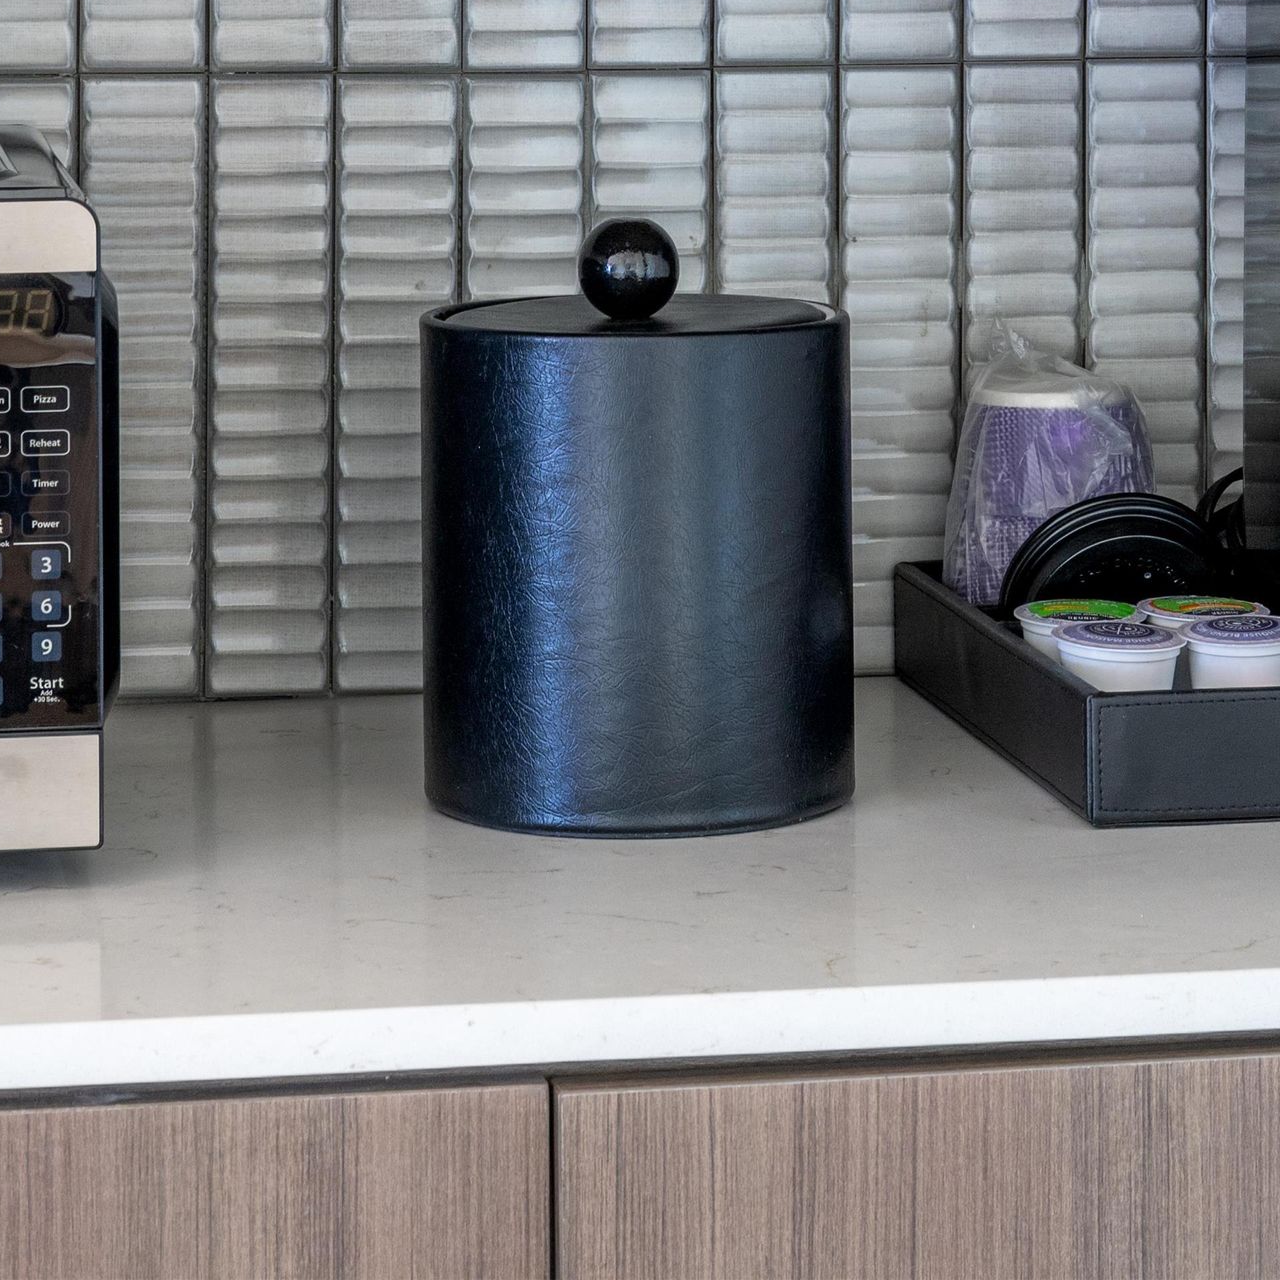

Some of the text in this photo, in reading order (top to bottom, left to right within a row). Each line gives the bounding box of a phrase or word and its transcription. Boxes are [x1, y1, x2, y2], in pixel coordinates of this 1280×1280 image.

[33, 395, 56, 403] Pizza
[30, 439, 60, 447] Reheat
[32, 479, 58, 488] Timer
[32, 520, 59, 528] Power
[41, 557, 52, 573] 3
[41, 598, 52, 614] 6
[41, 639, 52, 655] 9
[30, 677, 64, 689] Start
